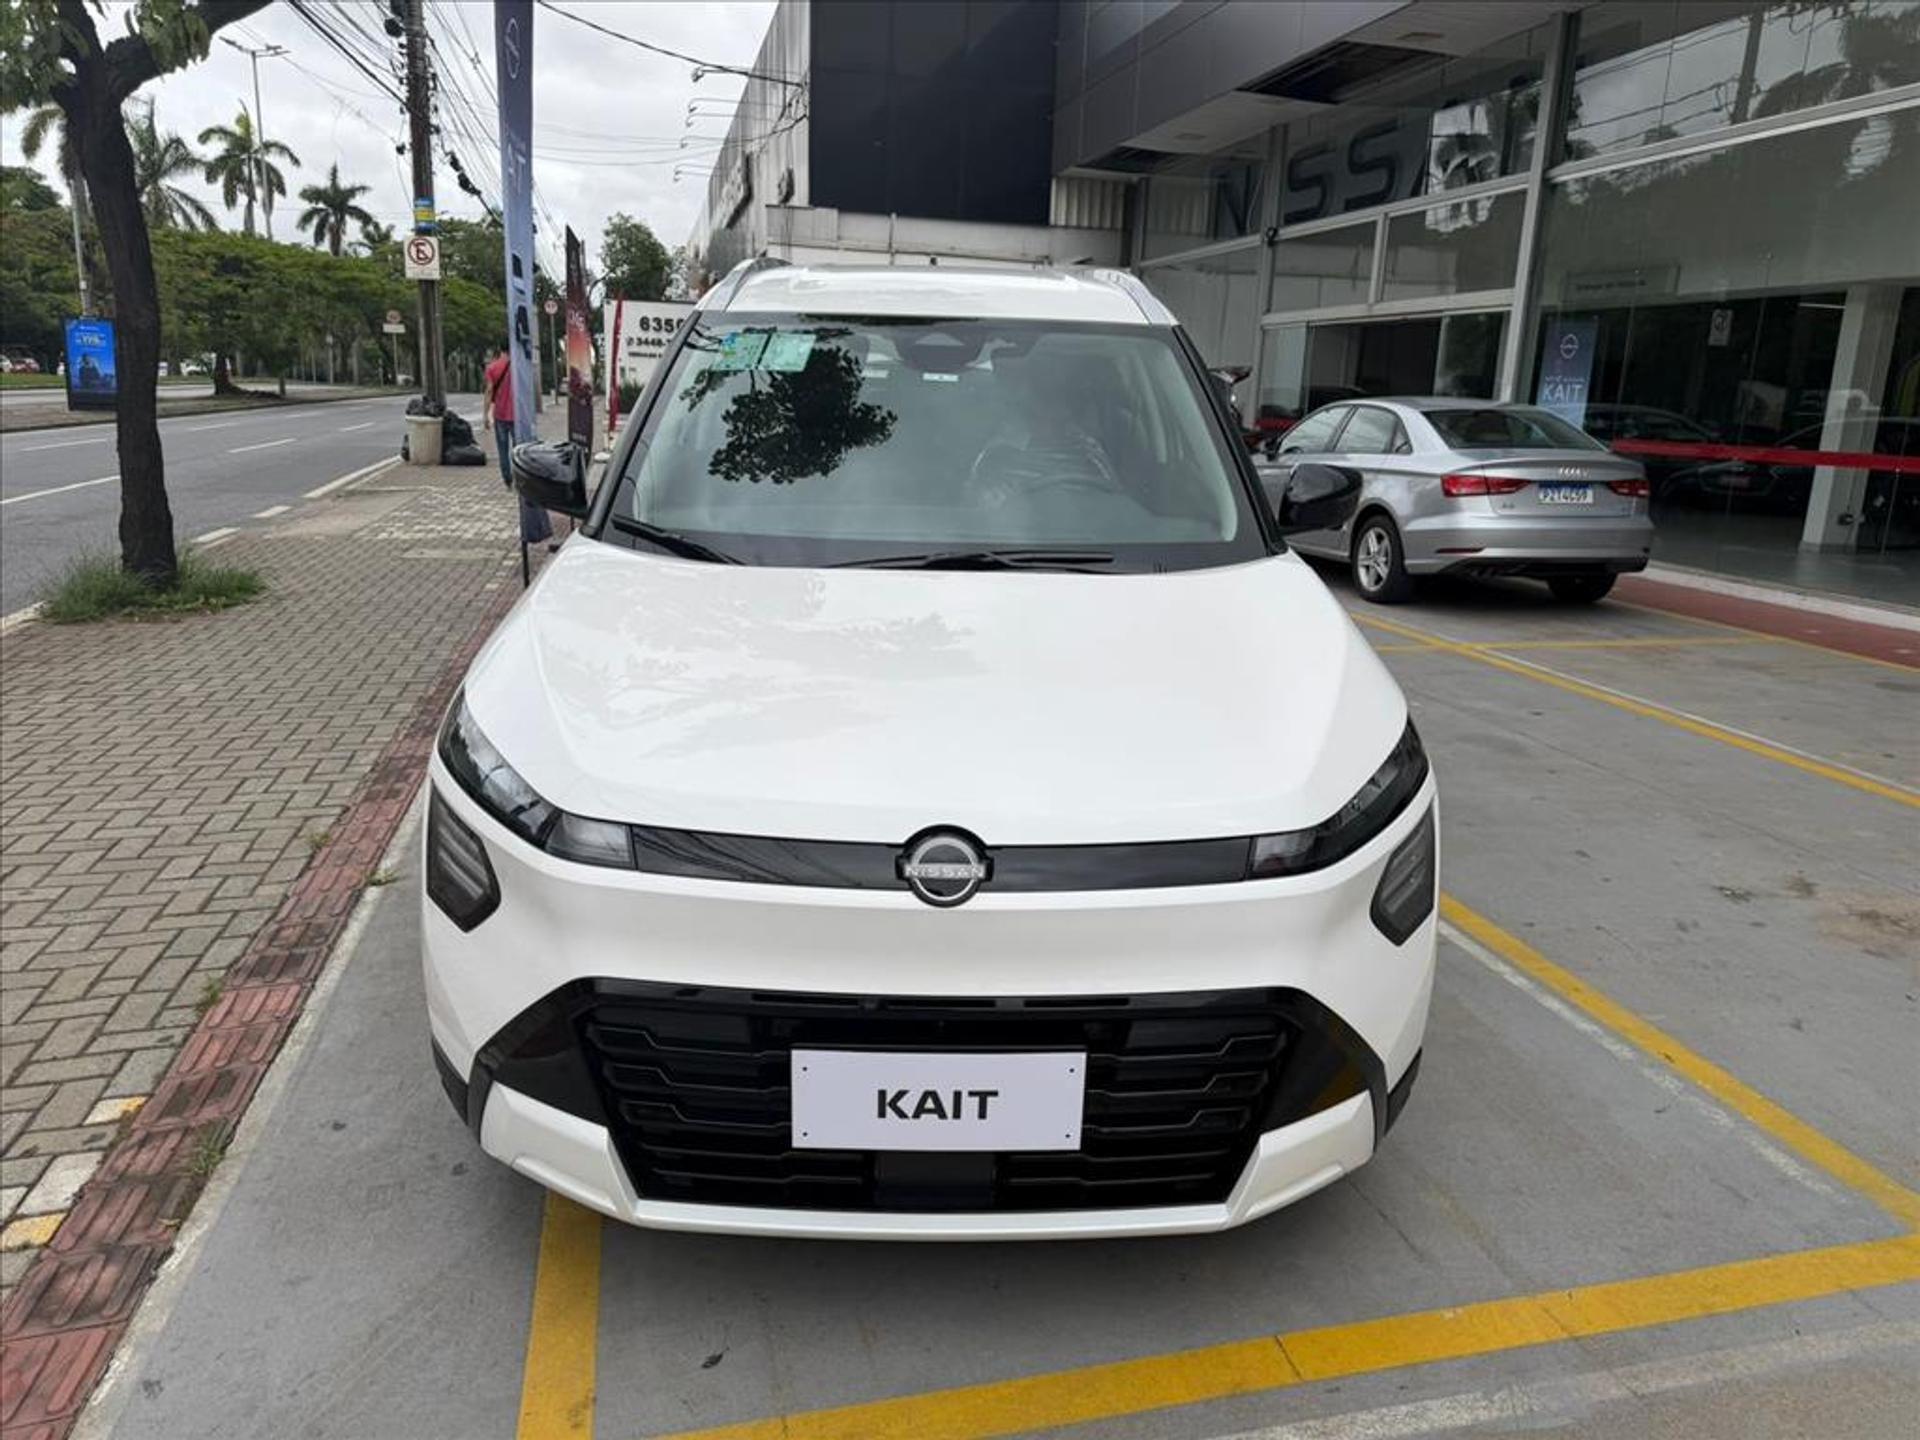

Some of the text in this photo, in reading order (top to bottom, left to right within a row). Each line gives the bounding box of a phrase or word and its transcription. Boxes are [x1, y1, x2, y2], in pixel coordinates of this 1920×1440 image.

[1543, 384, 1583, 402] KAIT
[904, 863, 985, 879] NISSAN
[877, 1089, 999, 1120] KAIT
